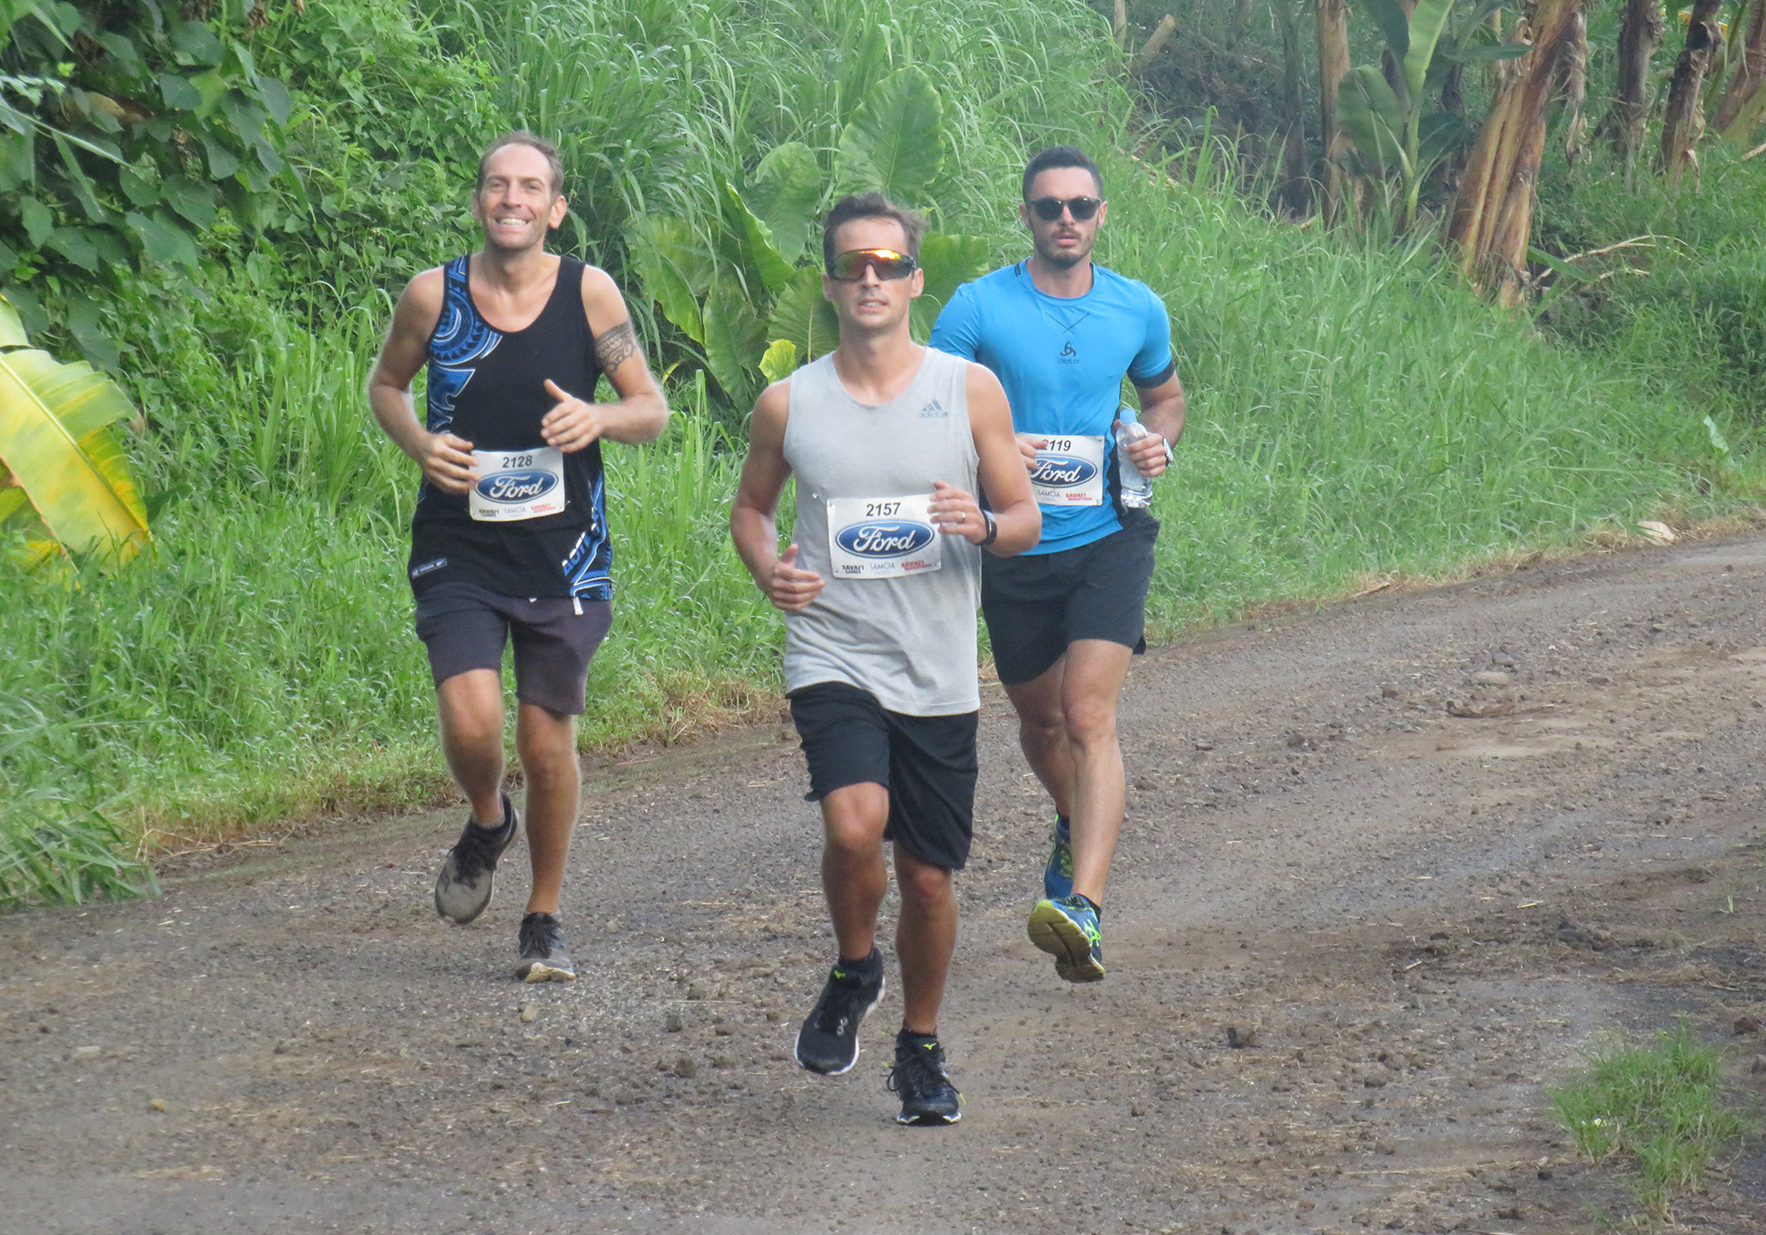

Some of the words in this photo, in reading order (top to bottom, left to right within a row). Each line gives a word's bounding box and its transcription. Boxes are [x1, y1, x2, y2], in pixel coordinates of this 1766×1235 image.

[502, 455, 533, 468] 2128
[1030, 458, 1082, 482] Ford
[489, 475, 544, 498] Ford
[866, 502, 901, 516] 2157
[853, 526, 916, 552] Ford
[870, 562, 896, 570] SAMOA
